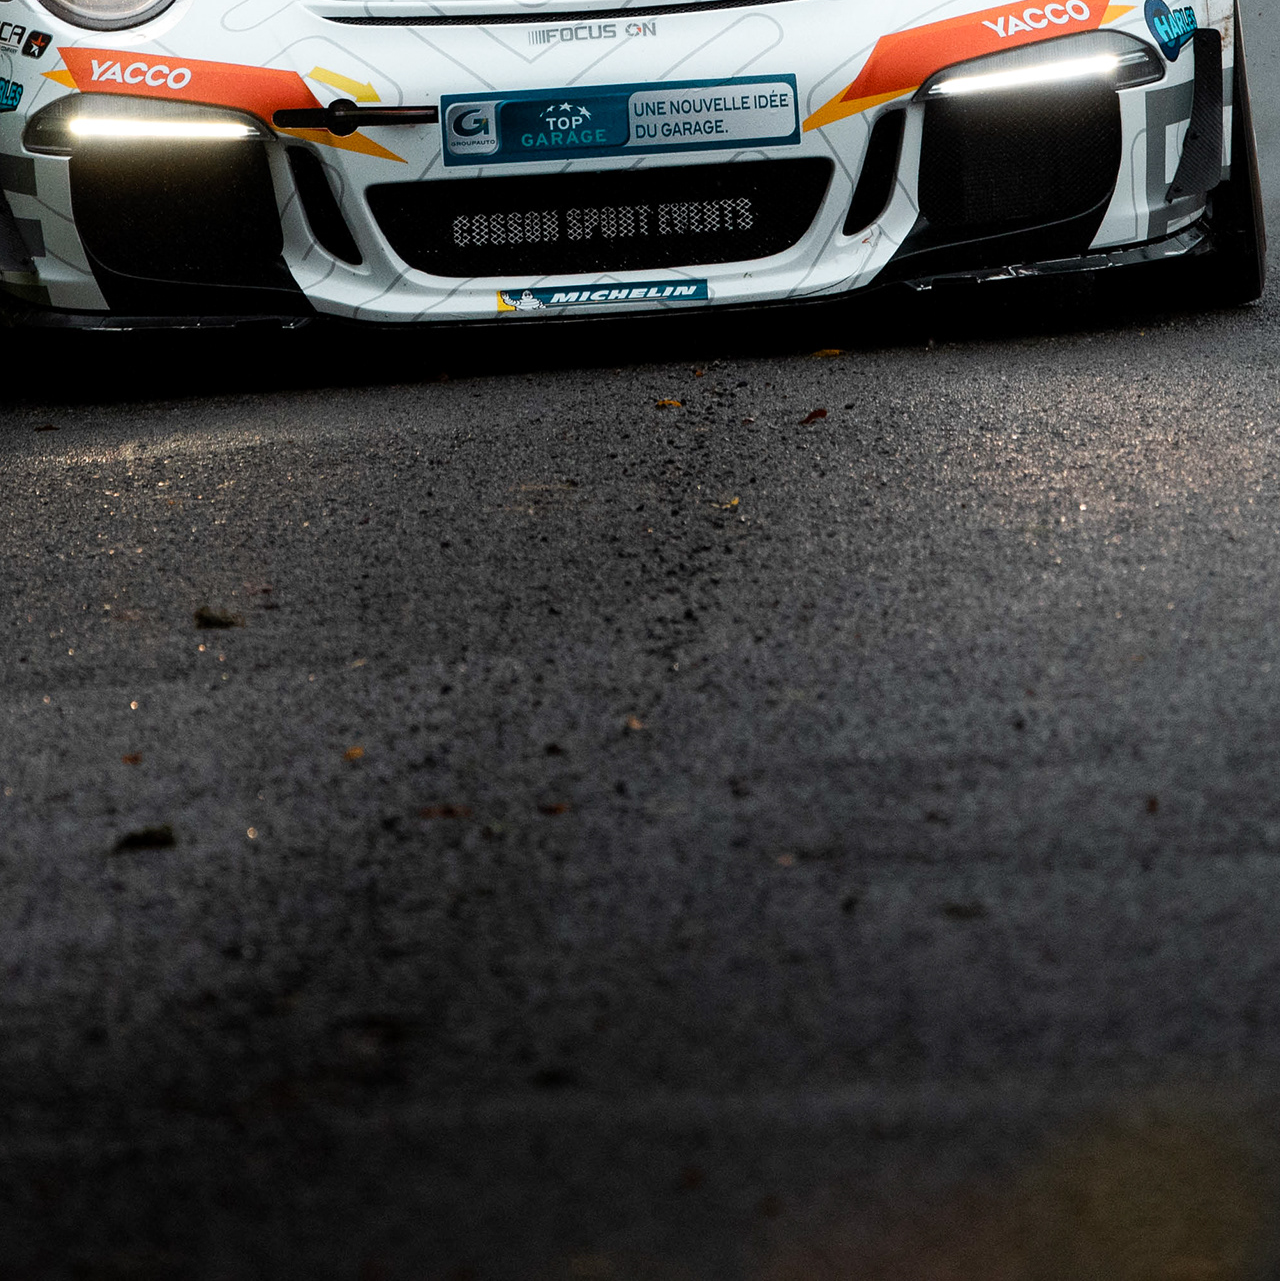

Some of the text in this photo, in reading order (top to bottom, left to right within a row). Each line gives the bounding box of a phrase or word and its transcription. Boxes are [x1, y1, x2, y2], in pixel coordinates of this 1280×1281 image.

[981, 0, 1091, 39] YACCO
[545, 23, 617, 44] FOCUS
[91, 59, 193, 90] YACCO
[633, 89, 789, 117] UNE NOUVELLE IDÉE
[545, 116, 584, 131] TOP
[635, 119, 729, 139] DU GARAGE.
[450, 138, 496, 147] GROUPAUTO
[521, 129, 607, 148] GARAGE
[565, 204, 653, 241] SPORT
[657, 197, 754, 235] EVENTS
[549, 285, 698, 304] MICHELIN
